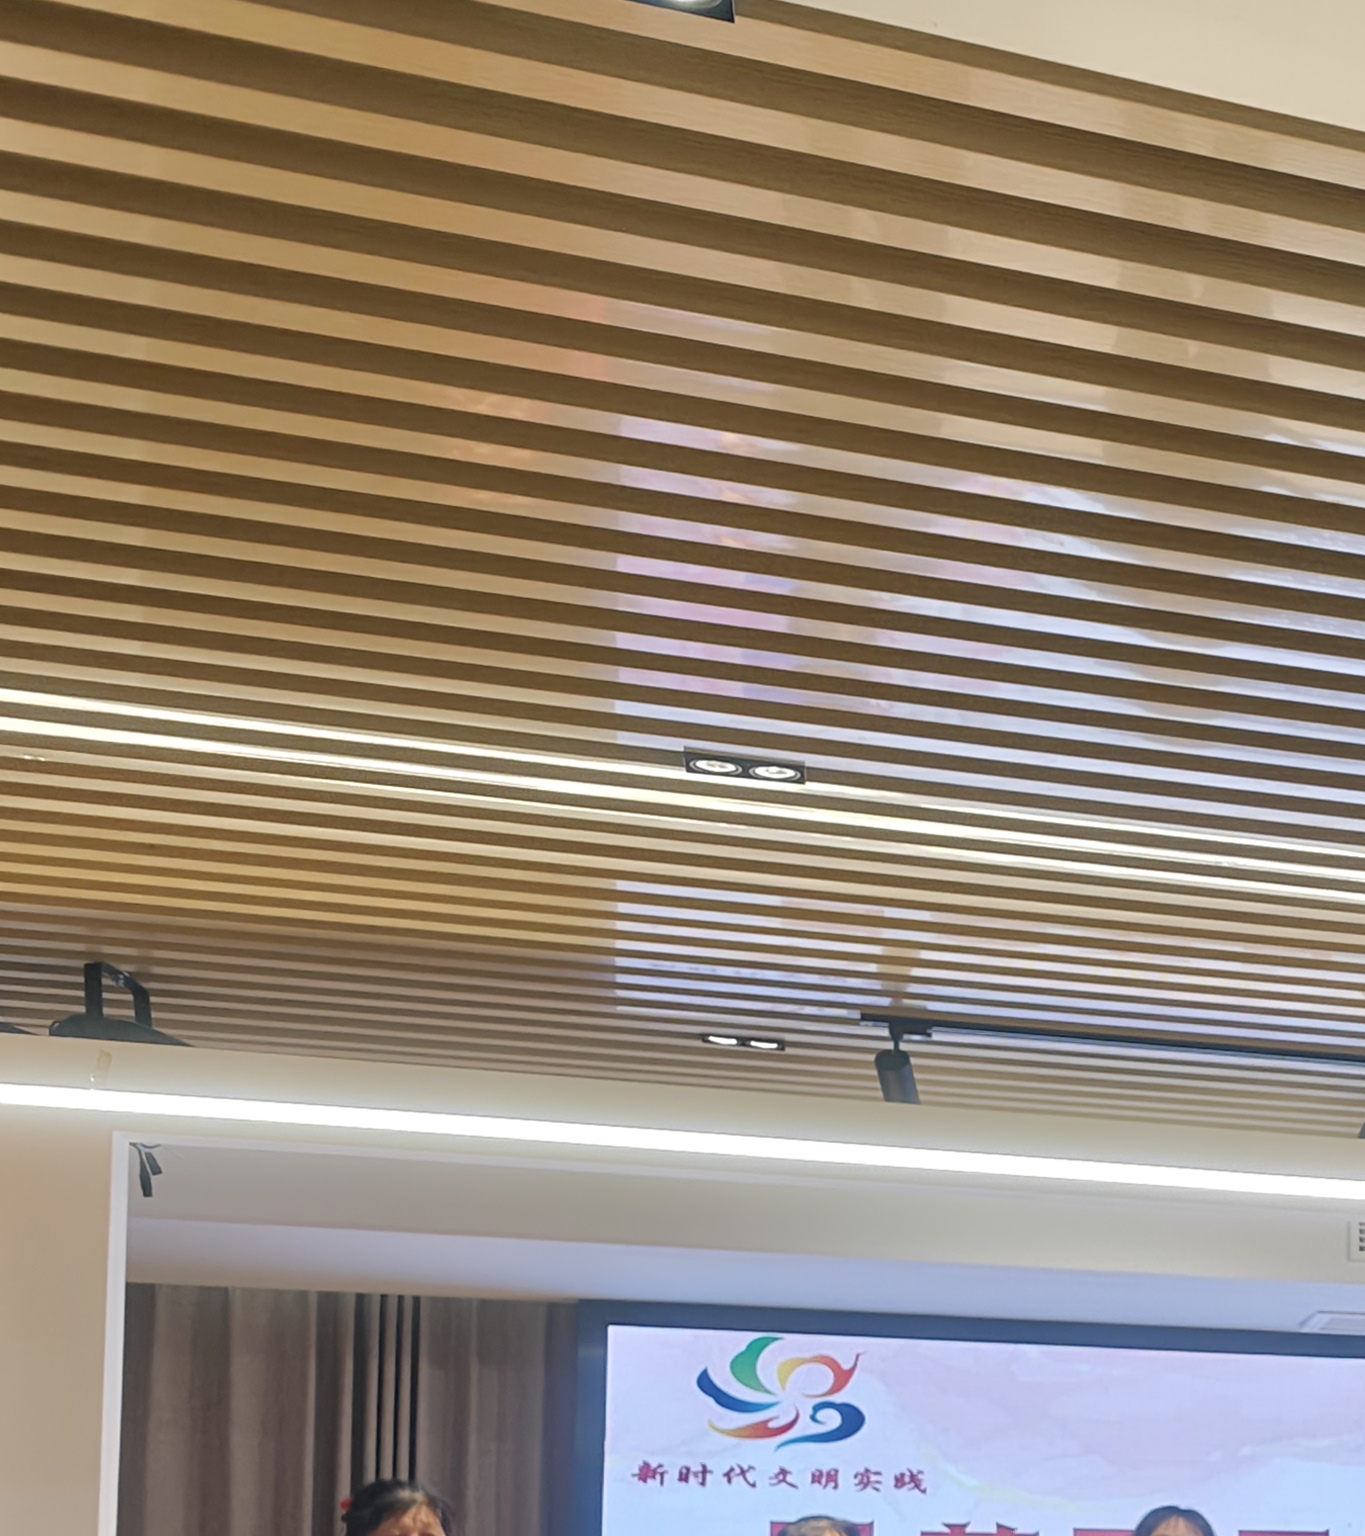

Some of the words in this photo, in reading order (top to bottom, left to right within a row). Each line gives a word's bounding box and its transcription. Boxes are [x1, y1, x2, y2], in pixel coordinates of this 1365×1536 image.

[631, 1460, 927, 1494] 新时代文明实践
